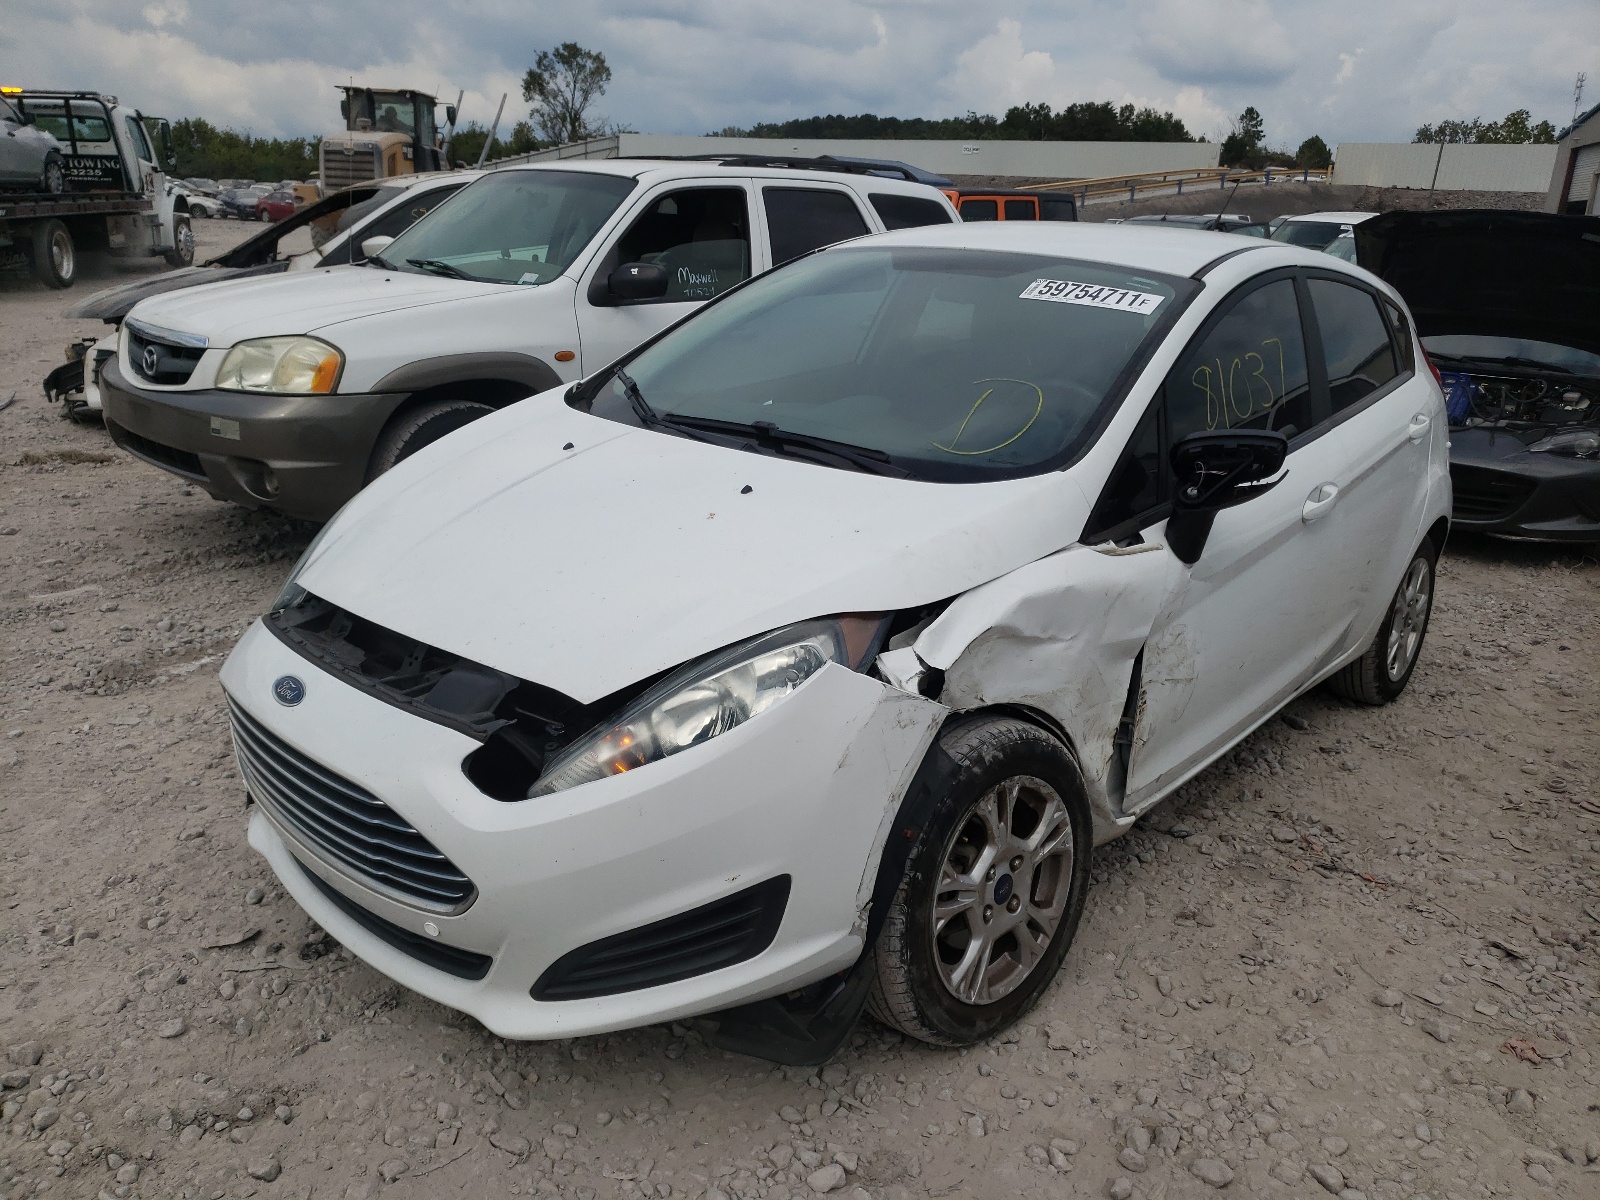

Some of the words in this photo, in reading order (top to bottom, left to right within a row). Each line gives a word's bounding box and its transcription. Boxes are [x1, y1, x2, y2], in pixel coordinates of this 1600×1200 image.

[68, 158, 120, 169] TOWING
[677, 266, 720, 285] Maxwell
[1192, 337, 1287, 431] 81037
